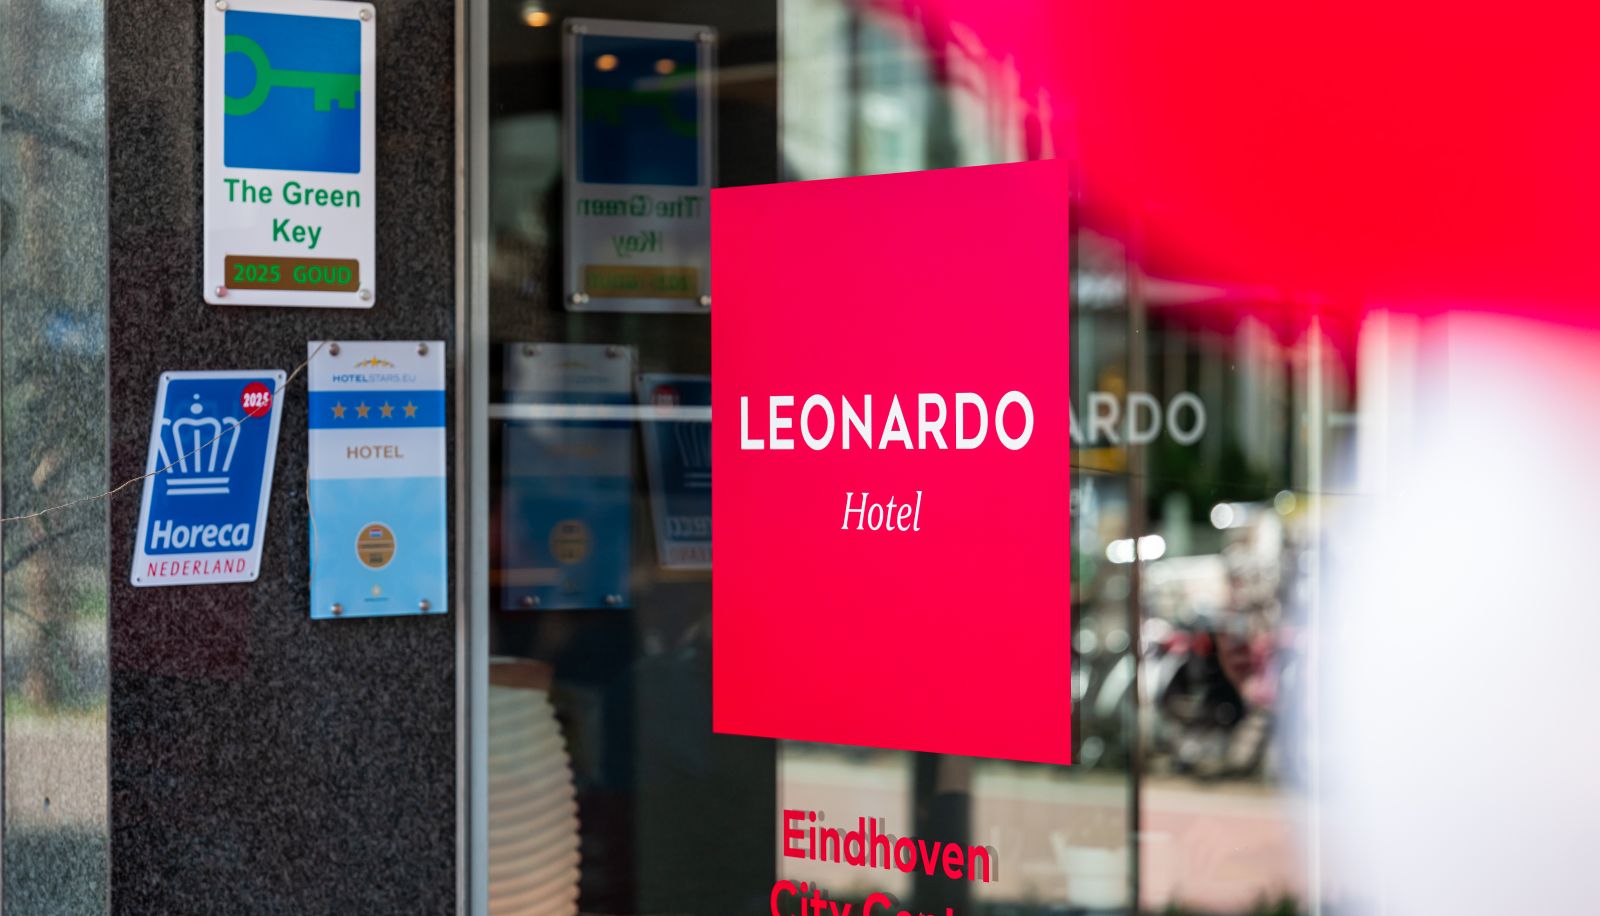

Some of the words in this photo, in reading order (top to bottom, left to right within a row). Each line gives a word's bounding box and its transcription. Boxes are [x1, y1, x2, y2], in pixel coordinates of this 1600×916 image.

[223, 178, 273, 204] The
[282, 181, 361, 208] Green
[272, 218, 322, 250] Key
[233, 263, 281, 283] 2025
[293, 265, 352, 285] GOUD
[243, 391, 269, 408] 2025
[740, 390, 1034, 451] LEONARDO
[346, 445, 404, 459] HOTEL
[841, 490, 923, 532] Hotel
[150, 519, 250, 550] Horeca
[147, 558, 246, 577] NEDERLAND
[783, 809, 990, 883] Eindhoven
